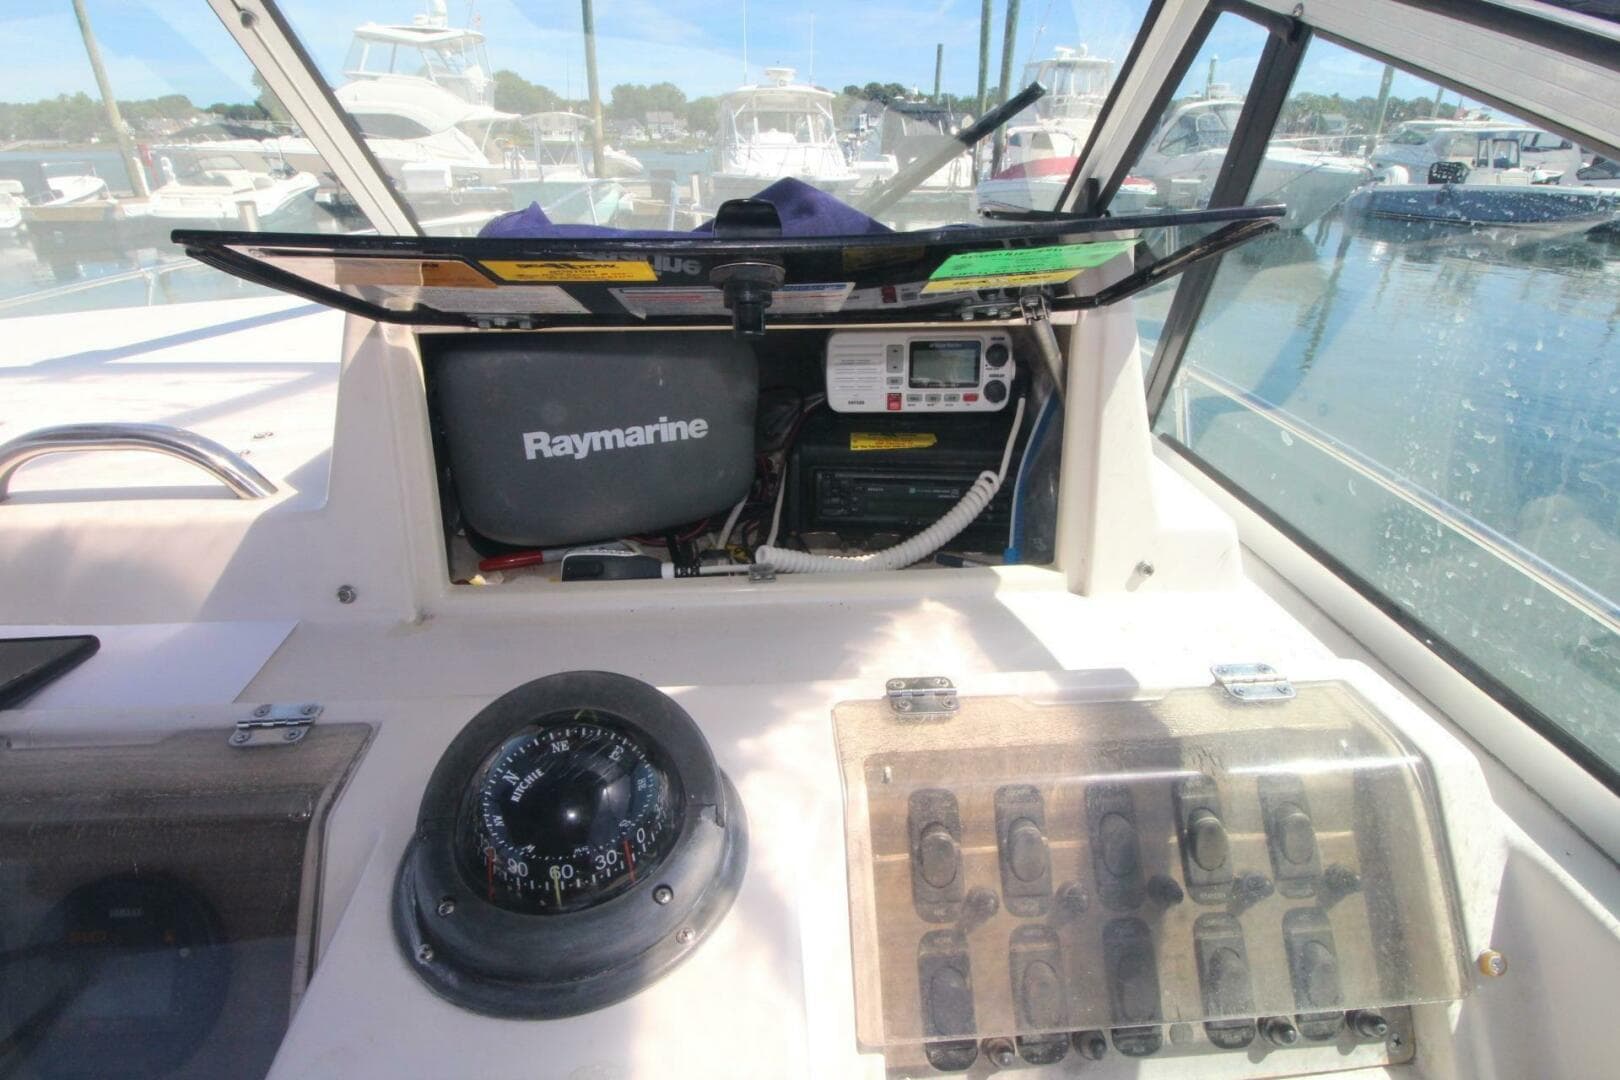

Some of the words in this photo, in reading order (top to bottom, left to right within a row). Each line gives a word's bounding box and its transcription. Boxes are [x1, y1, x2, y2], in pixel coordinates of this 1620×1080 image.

[522, 416, 709, 460] Raymarine
[551, 739, 570, 753] NE
[608, 745, 624, 761] E
[502, 769, 520, 786] N
[510, 768, 545, 803] RITCHIE
[507, 858, 529, 878] 90
[595, 849, 618, 870] 30
[549, 864, 574, 881] 60
